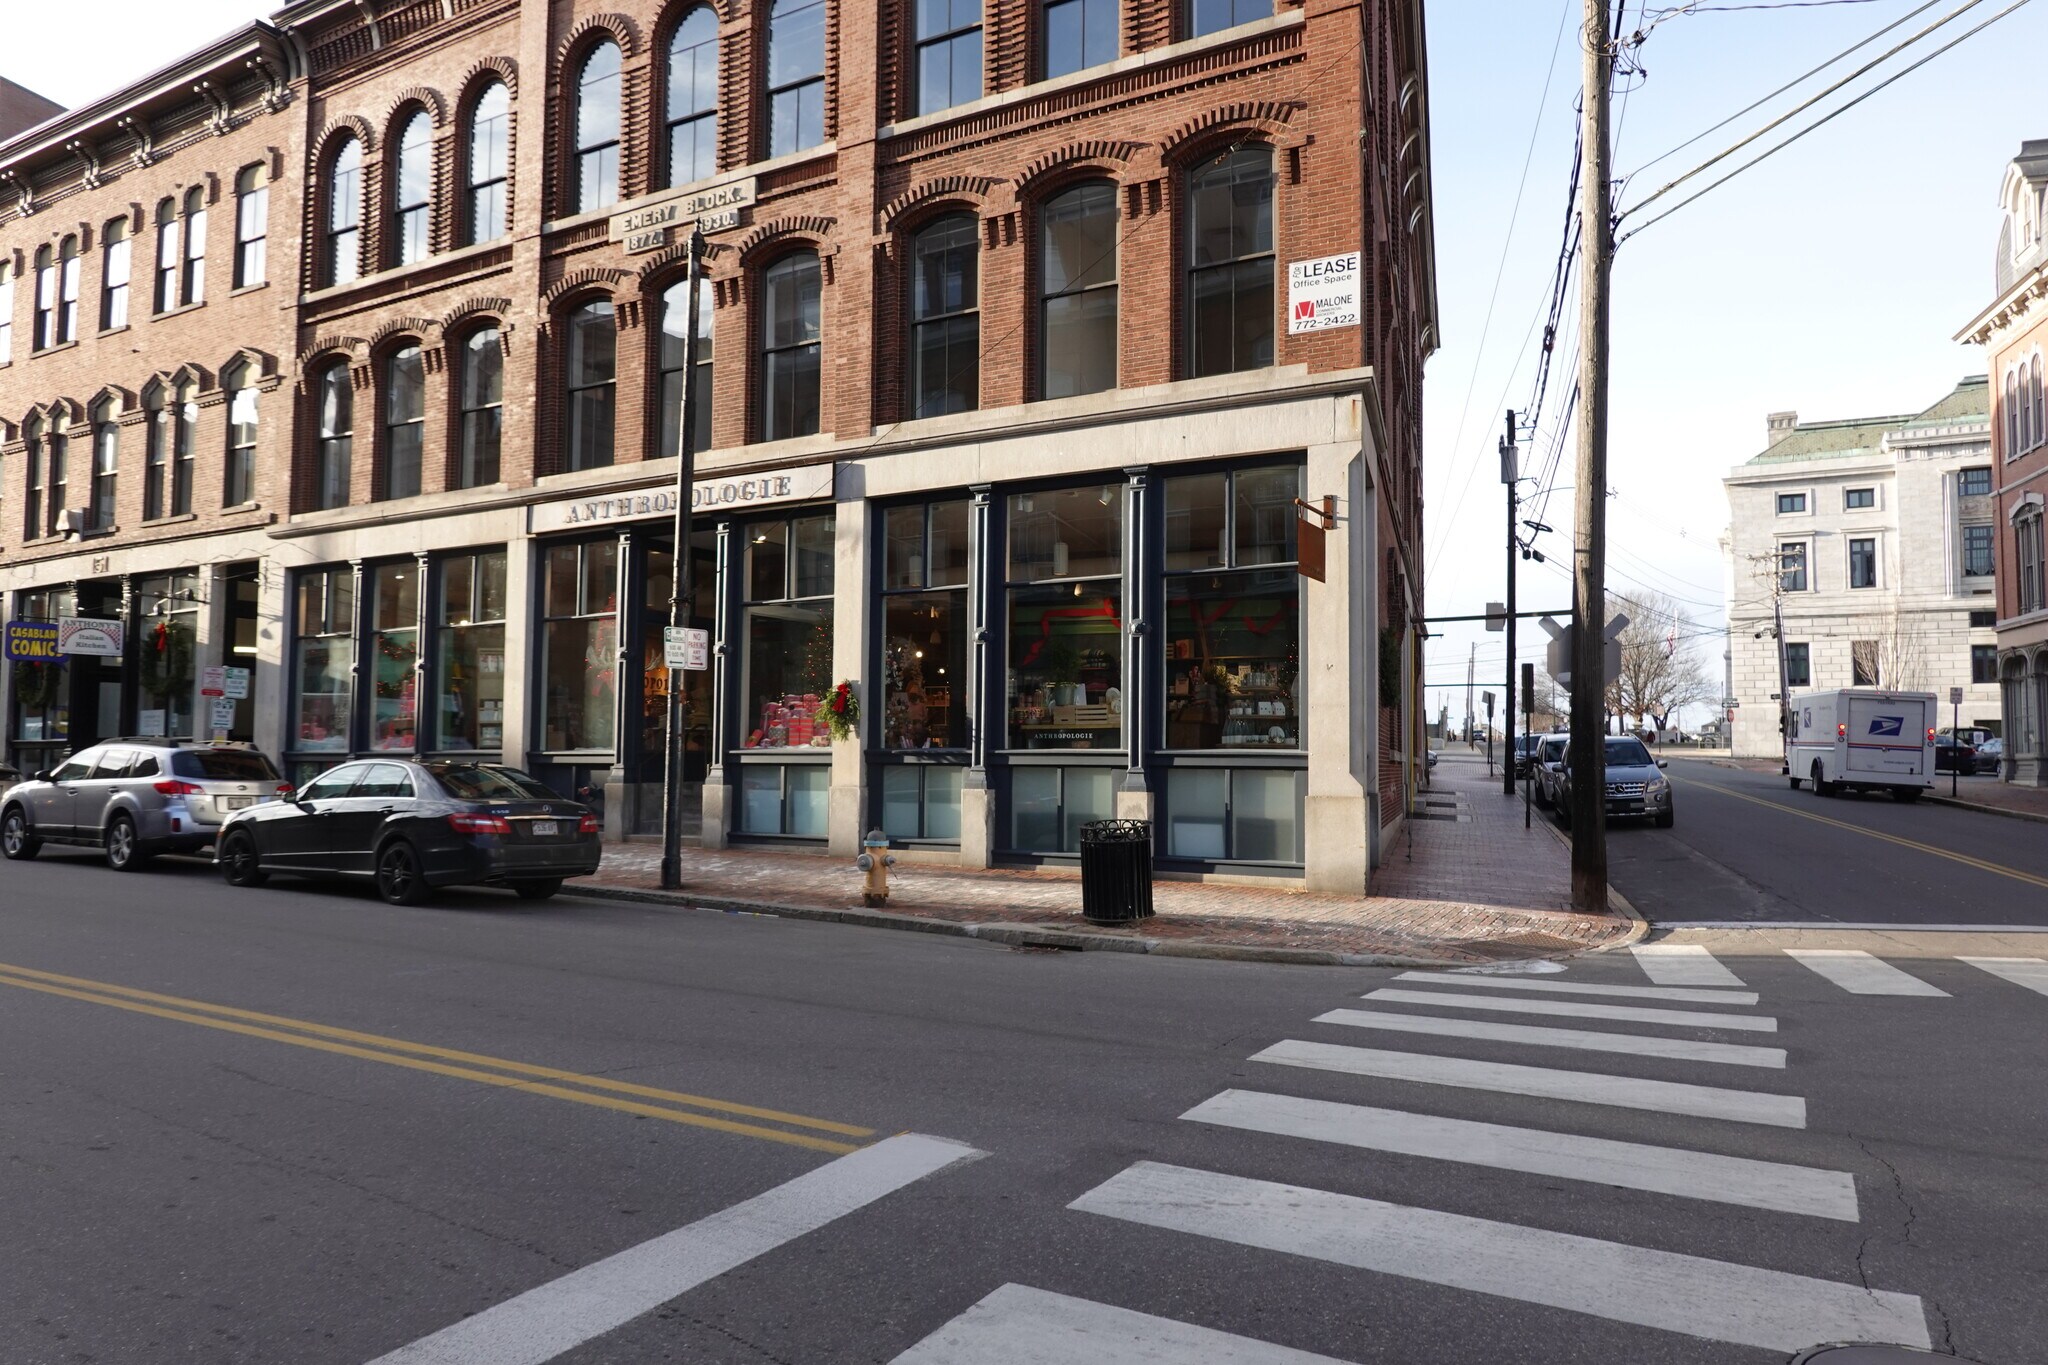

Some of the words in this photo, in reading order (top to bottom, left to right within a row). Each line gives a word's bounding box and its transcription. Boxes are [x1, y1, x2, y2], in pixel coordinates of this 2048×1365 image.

[623, 206, 673, 232] EMERY
[1304, 257, 1357, 278] LEASE
[1293, 279, 1320, 288] Office
[1324, 274, 1352, 285] Space
[1316, 294, 1353, 308] MALONE
[1295, 314, 1355, 330] 772-2422
[10, 627, 59, 639] CASABLAN
[693, 633, 702, 641] NO
[11, 639, 63, 657] COMIC
[688, 641, 706, 649] PARKING
[1034, 732, 1094, 740] ANTHROPOLOGIE
